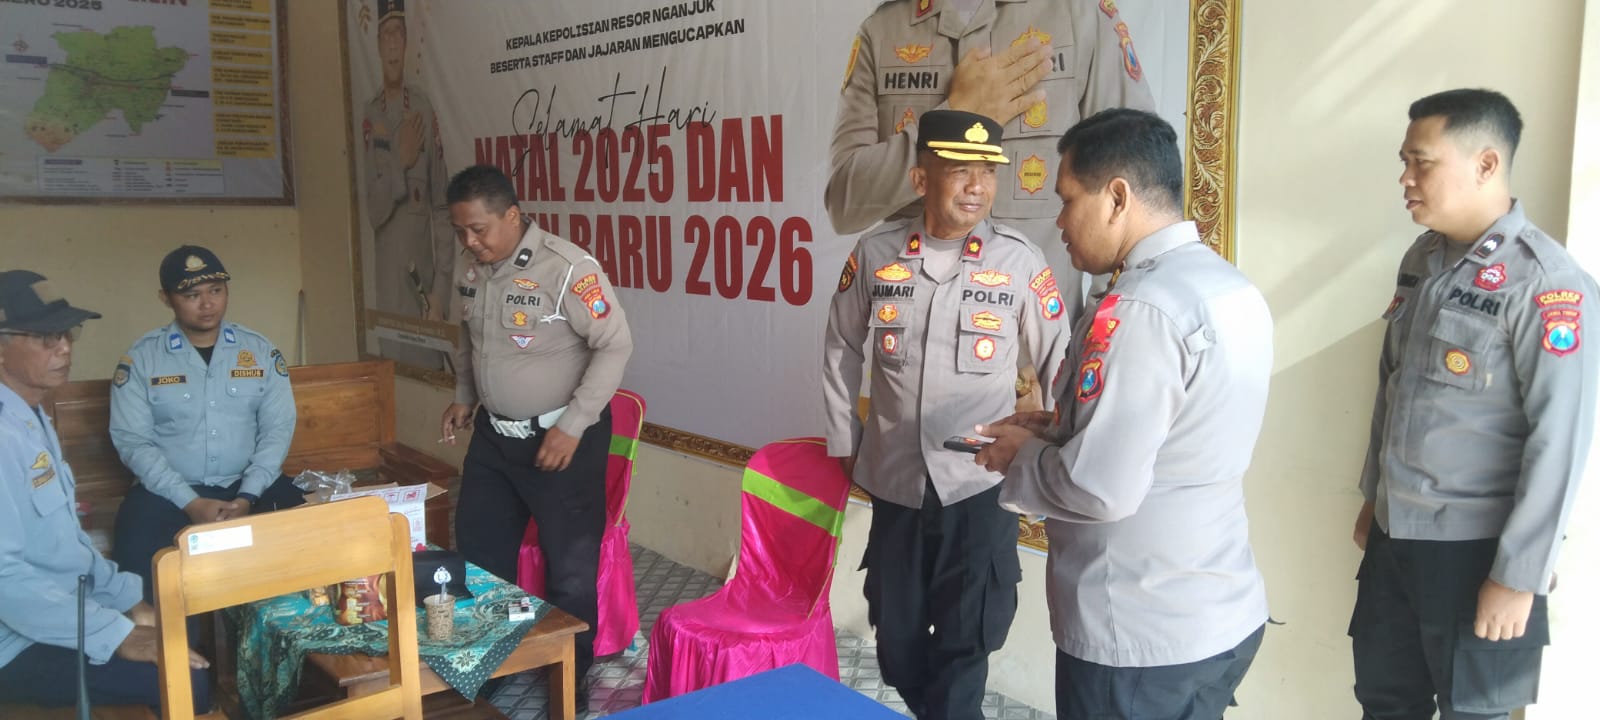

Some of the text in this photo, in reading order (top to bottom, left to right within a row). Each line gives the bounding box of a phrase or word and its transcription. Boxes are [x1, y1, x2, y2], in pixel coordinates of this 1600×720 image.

[505, 0, 716, 51] KEPALA KEPOLISIAN RESOR NGANJUK
[490, 18, 746, 74] BESERTA STAFF DAN JAJARAN MENGUCAPKAN
[884, 70, 939, 90] HENRI
[511, 65, 717, 177] Selamat Hari
[572, 123, 675, 203] 2025
[685, 114, 784, 203] DAN
[683, 214, 814, 307] 2026
[505, 294, 541, 307] POLRI
[872, 283, 915, 298] JUMARI
[962, 289, 1015, 306] POLRI
[1449, 287, 1501, 316] POLRI
[1539, 291, 1581, 302] POLRES
[157, 376, 181, 384] JOKO
